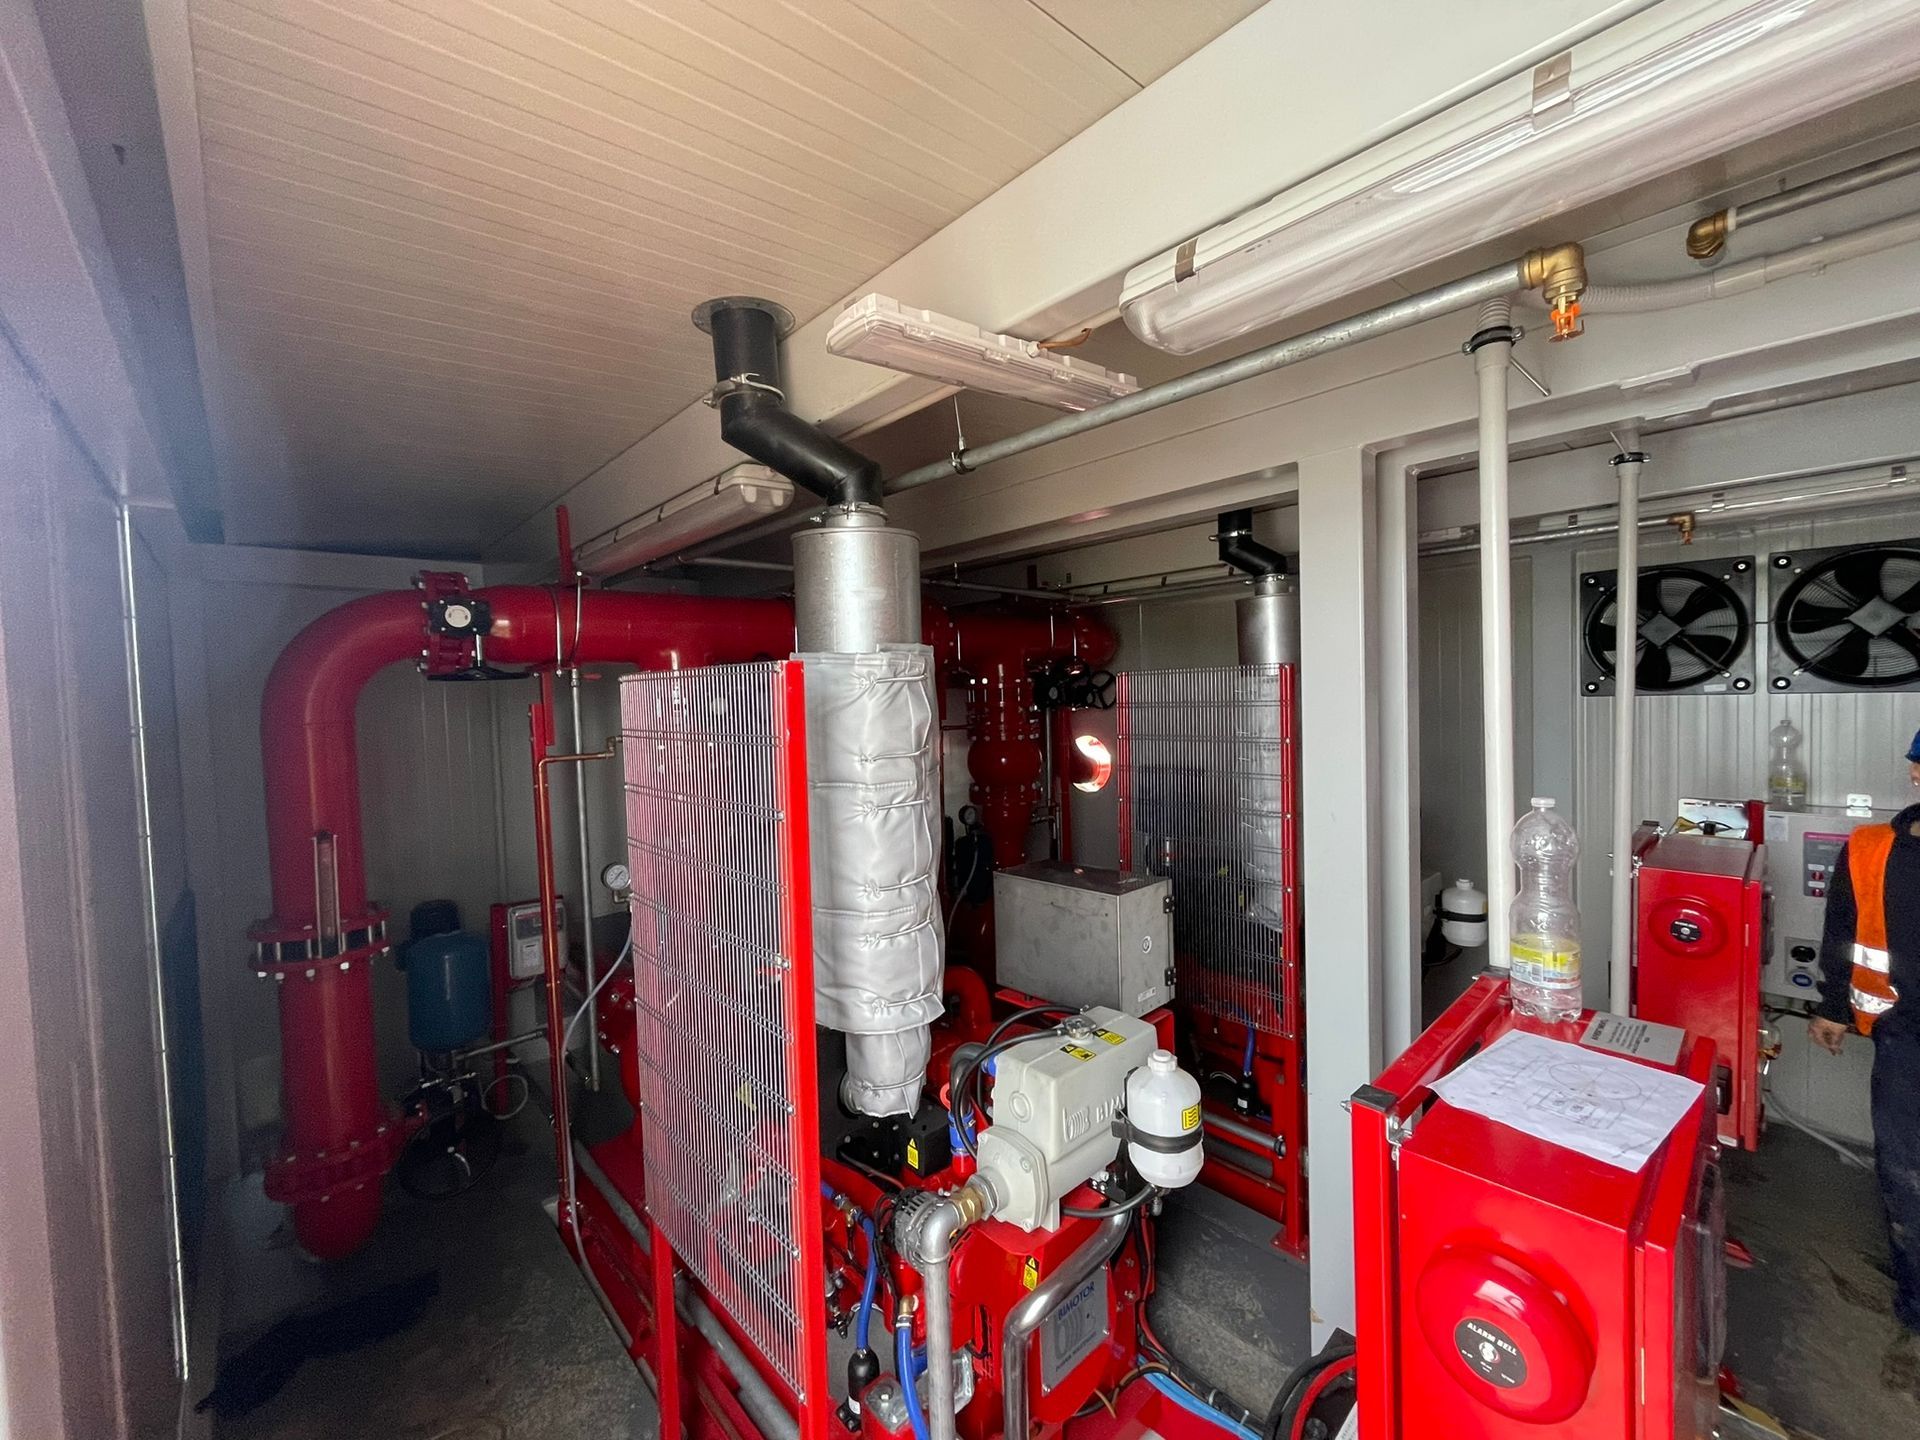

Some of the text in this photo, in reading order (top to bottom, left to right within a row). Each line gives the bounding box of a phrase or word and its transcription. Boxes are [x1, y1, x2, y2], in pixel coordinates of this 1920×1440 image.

[1058, 1281, 1095, 1320] BIMOTOR
[1466, 1322, 1517, 1356] ALARM BELL
